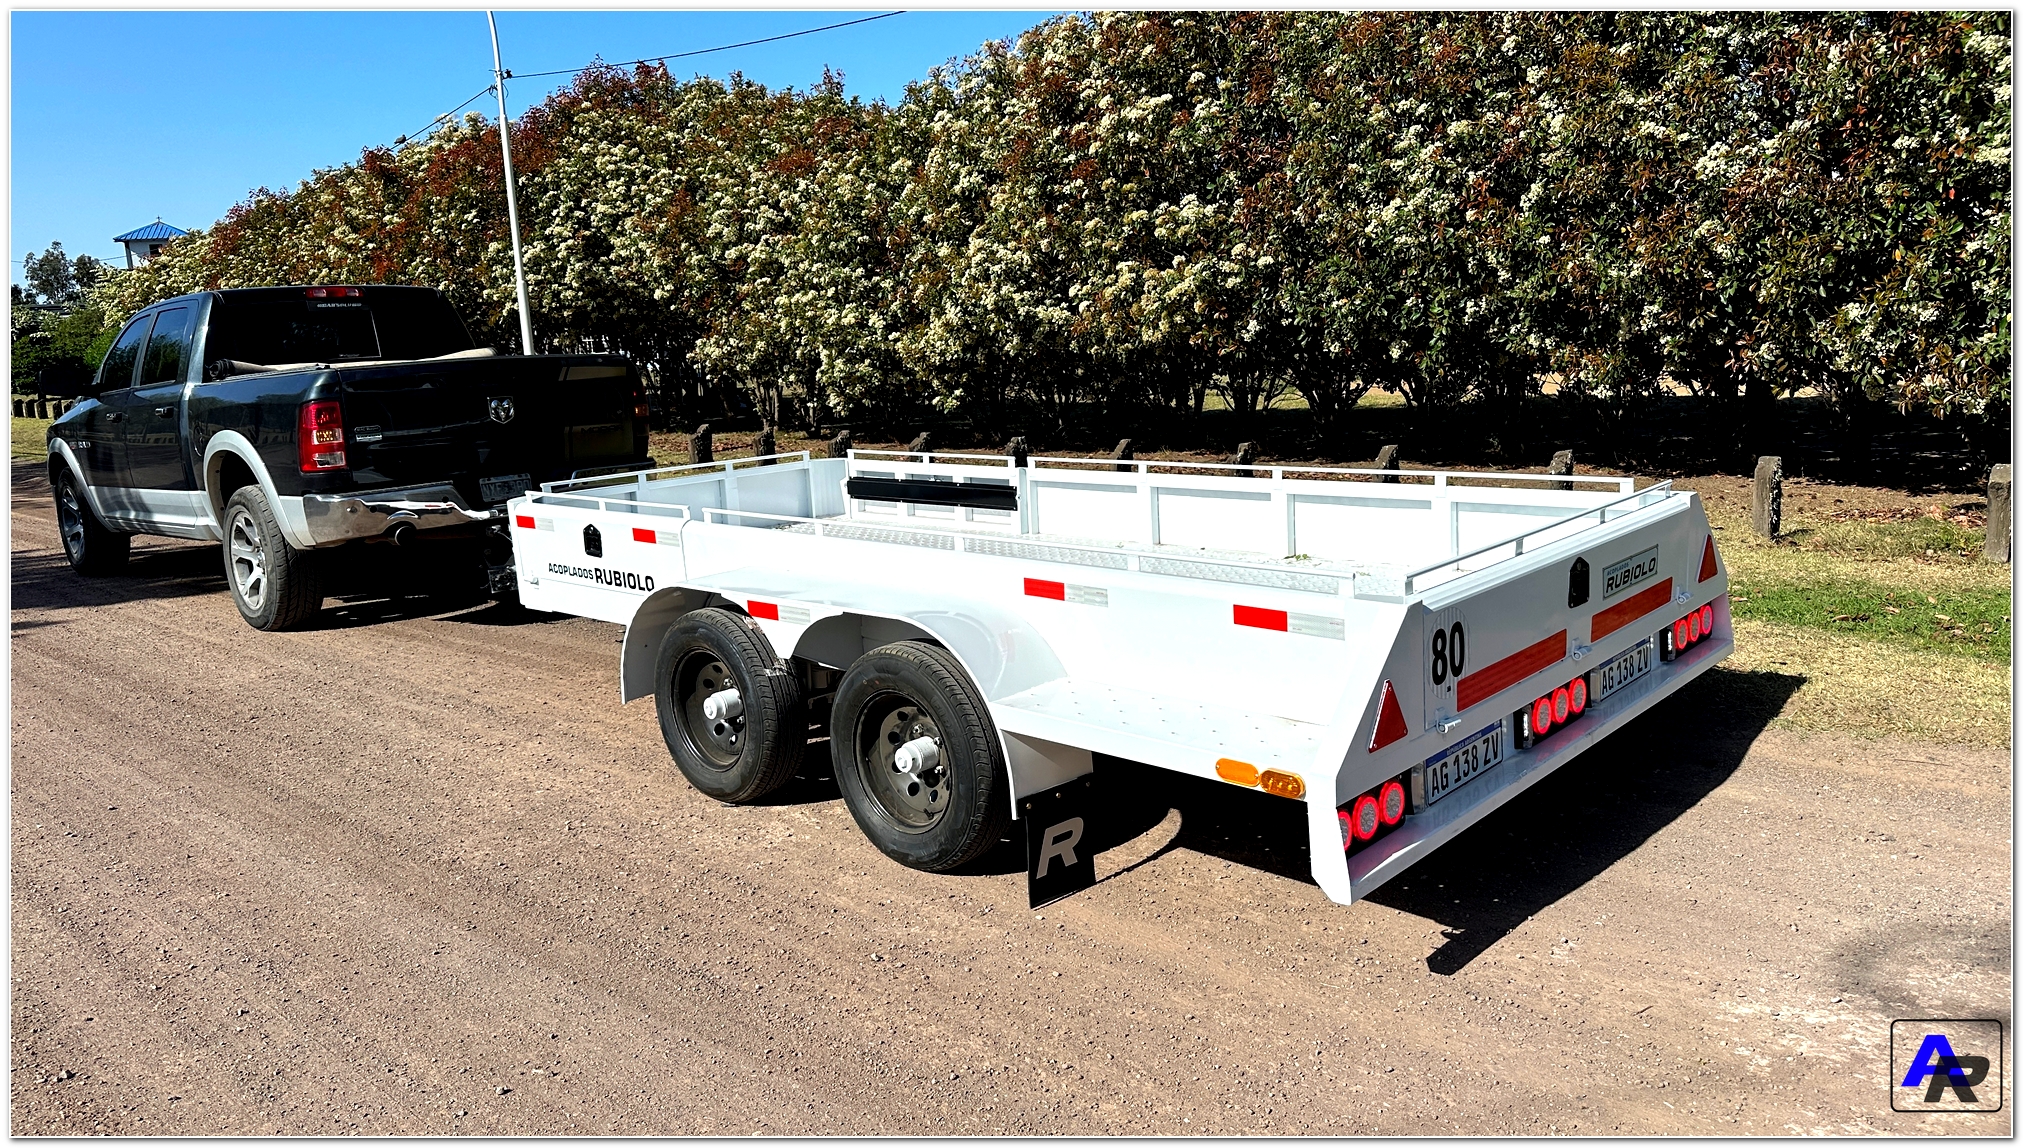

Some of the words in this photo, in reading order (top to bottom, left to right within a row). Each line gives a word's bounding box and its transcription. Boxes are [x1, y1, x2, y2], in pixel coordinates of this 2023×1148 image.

[548, 562, 594, 580] ACOPLADOS
[594, 567, 655, 592] RUBIOLO
[1605, 557, 1656, 593] RUBIOLO
[1432, 621, 1465, 685] 80
[1601, 666, 1614, 696] AG
[1616, 654, 1635, 686] 138
[1636, 644, 1650, 674] ZV
[1431, 760, 1449, 798] AG
[1453, 744, 1479, 784] 138
[1482, 731, 1499, 767] ZV
[1035, 816, 1084, 880] R
